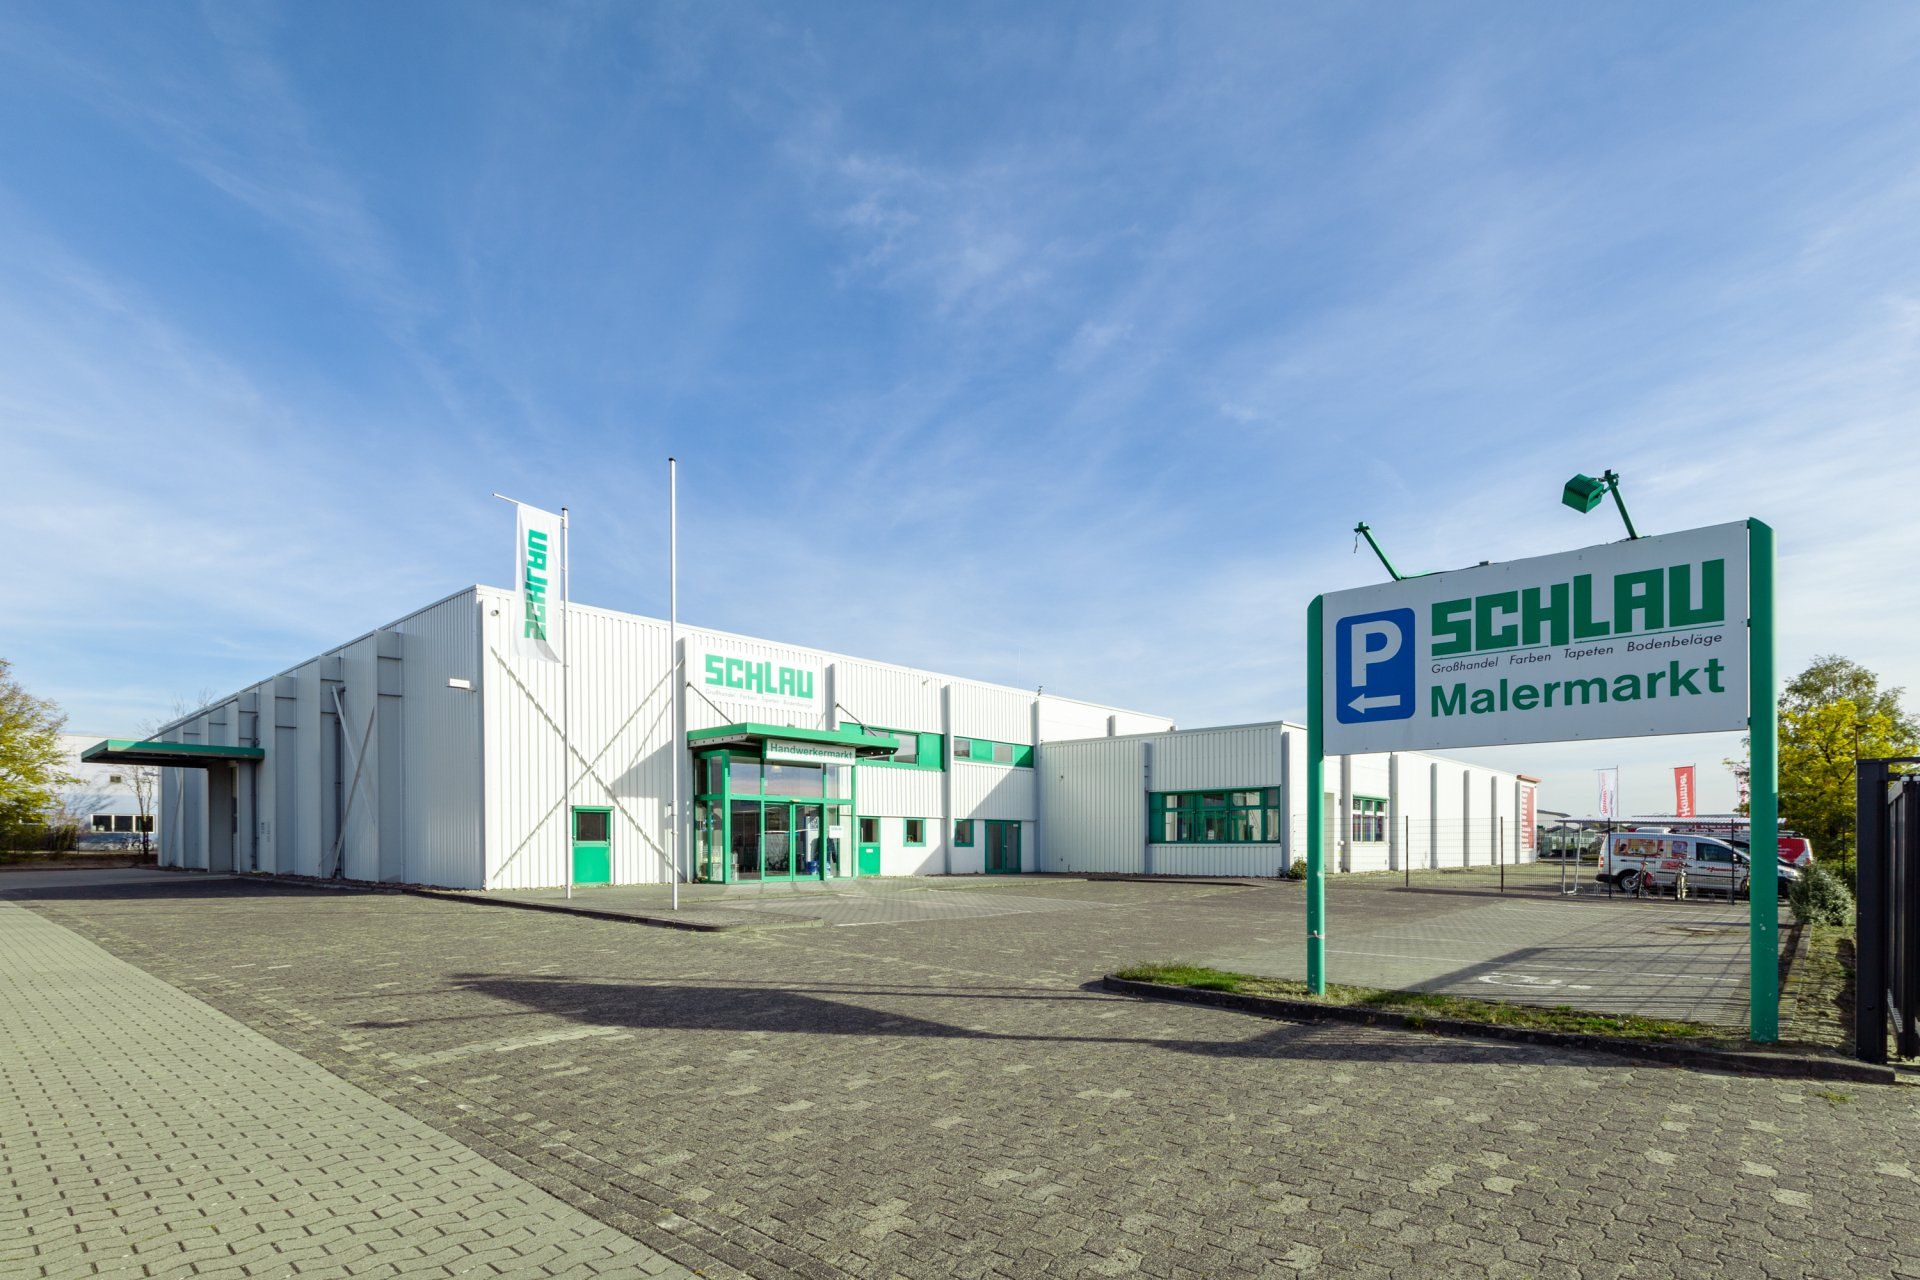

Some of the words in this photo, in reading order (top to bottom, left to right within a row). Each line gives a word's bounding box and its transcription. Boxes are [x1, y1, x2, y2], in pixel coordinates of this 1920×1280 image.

[1431, 559, 1725, 657] SCHLAU
[705, 653, 813, 699] SCHLAU
[1351, 619, 1403, 688] P
[1431, 656, 1499, 674] Großhandel
[1509, 652, 1552, 665] Farben
[1563, 646, 1614, 661] Tapeten
[1626, 633, 1723, 652] Bodenbeläge
[1431, 658, 1725, 717] Malermarkt
[770, 743, 853, 759] Handwerkermarkt
